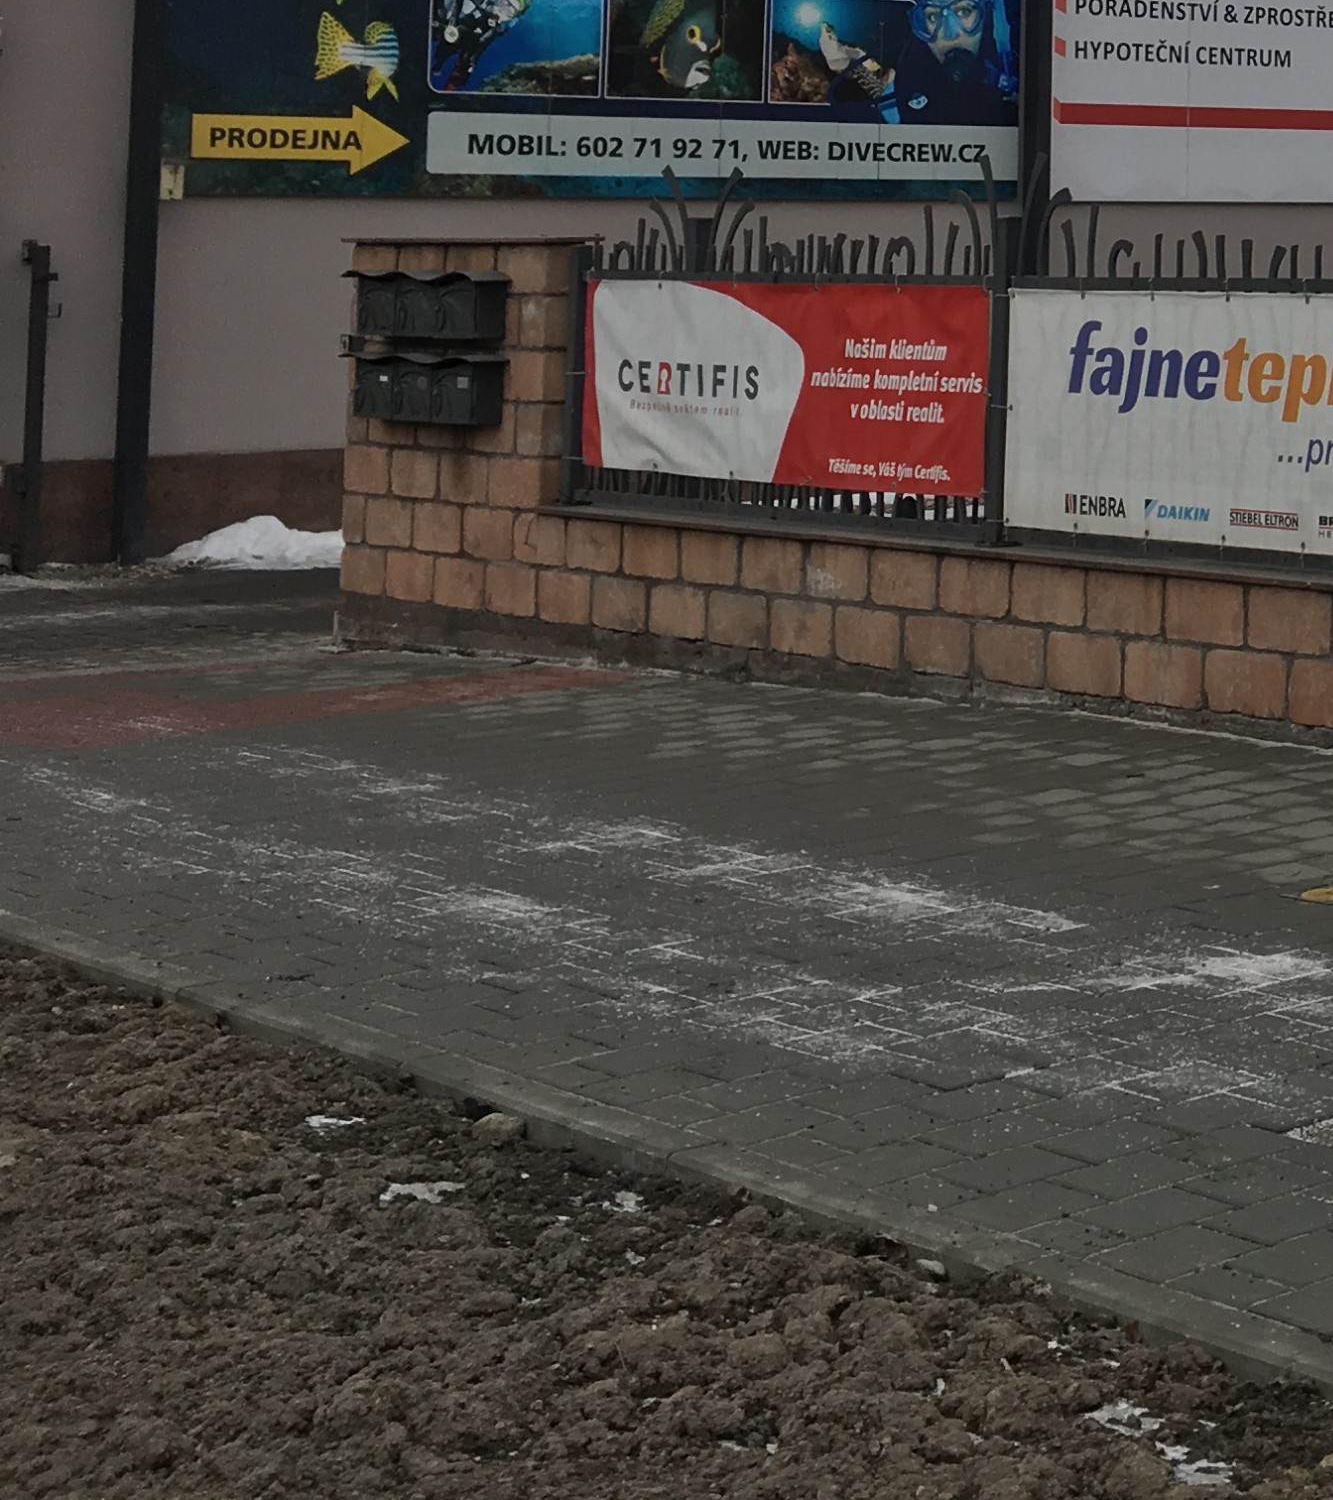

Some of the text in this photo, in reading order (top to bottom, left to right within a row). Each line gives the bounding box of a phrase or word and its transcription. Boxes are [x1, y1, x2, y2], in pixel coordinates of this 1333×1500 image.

[1223, 4, 1239, 24] &
[1074, 39, 1292, 68] HYPOTEČNÍ CENTRUM
[209, 128, 362, 151] PRODEJNA
[467, 133, 986, 163] MOBIL: 602 71 92 71, WEB: DIVECREW.CZ
[845, 338, 948, 361] Našim klientům
[618, 359, 759, 400] CERTIFIS
[811, 367, 983, 395] nabízíme kompletní servis
[850, 399, 945, 423] v oblasti realit.
[1080, 495, 1126, 518] ENBRA
[1157, 504, 1210, 522] DAIKIN
[1229, 511, 1299, 528] STIEBEL ELTRON
